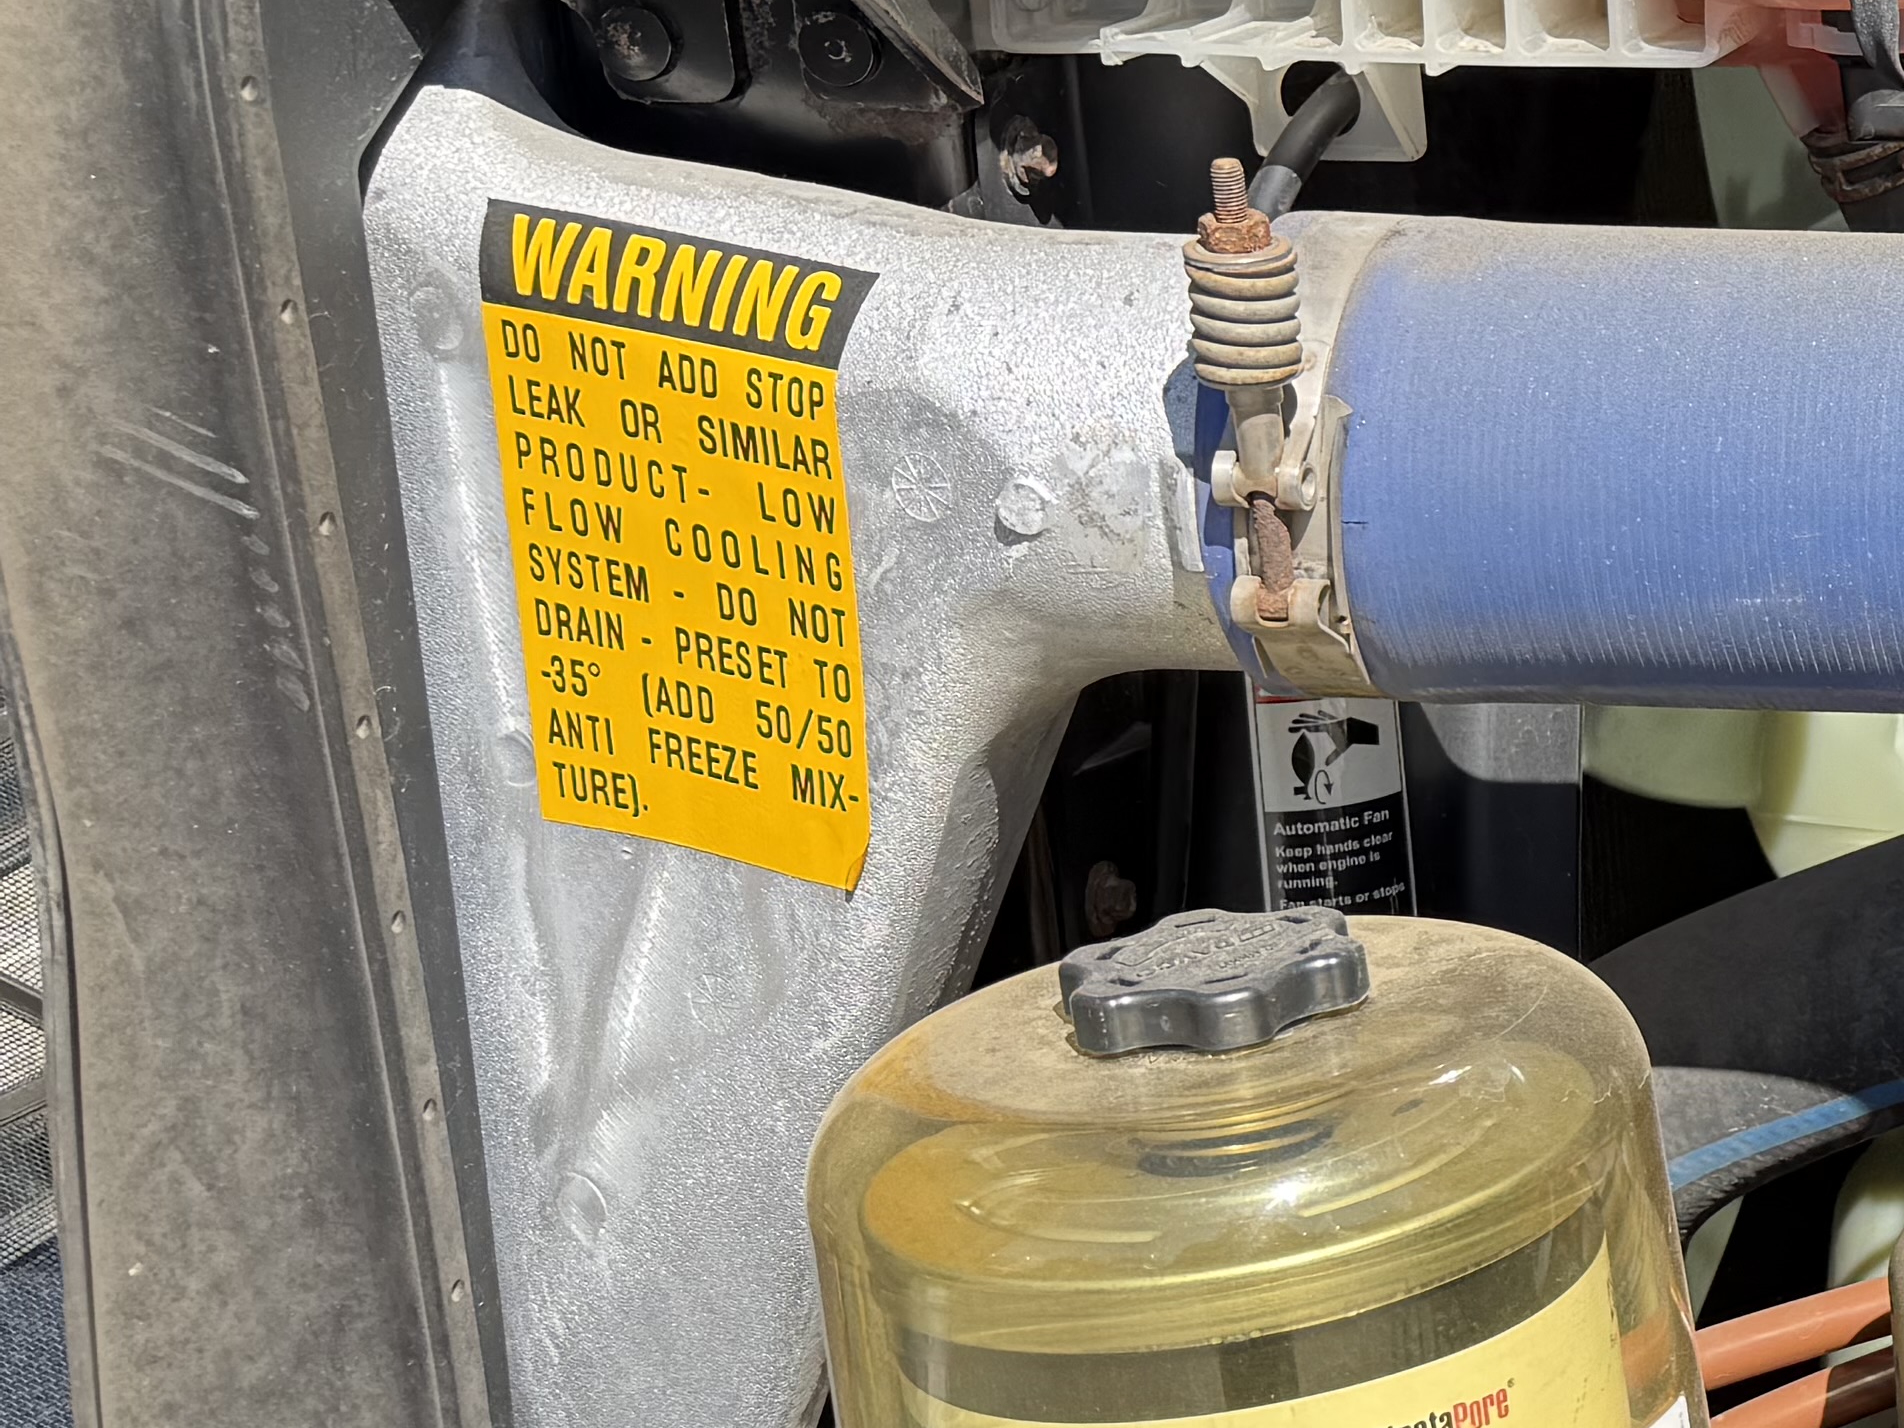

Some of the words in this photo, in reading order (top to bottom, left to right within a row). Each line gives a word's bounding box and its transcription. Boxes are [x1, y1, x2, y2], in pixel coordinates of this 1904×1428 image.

[511, 213, 842, 352] WARNING
[501, 319, 540, 363] DO
[568, 331, 627, 380] NOT
[658, 350, 717, 399] ADD
[745, 367, 824, 420] STOP
[508, 375, 586, 428] LEAK
[621, 399, 662, 444] OR
[698, 415, 833, 480] SIMILAR
[522, 488, 622, 543] FLOW
[665, 519, 843, 592] COOLING
[757, 481, 835, 534] LOW
[529, 543, 650, 604] SYSTEM
[717, 582, 757, 627] DO
[788, 597, 845, 647] NOT
[535, 598, 624, 651] DRAIN
[675, 626, 787, 689] PRESET
[813, 659, 851, 704] TO
[541, 655, 601, 698] -35°
[642, 672, 715, 724] (ADD
[756, 700, 852, 759] 50/50
[549, 708, 614, 755] ANTI
[648, 727, 759, 790] FREEZE
[791, 764, 859, 812] MIX-
[553, 761, 648, 818] TURE).
[1273, 815, 1359, 836] Automatic
[1364, 809, 1389, 825] Fan
[1275, 844, 1312, 860] Keep
[1317, 839, 1360, 855] hands
[1364, 832, 1393, 848] clear
[1276, 861, 1315, 874] when
[1319, 856, 1366, 873] engine
[1370, 851, 1380, 862] is
[1278, 876, 1338, 891] running.
[1355, 892, 1370, 903] or
[1373, 881, 1406, 900] stops
